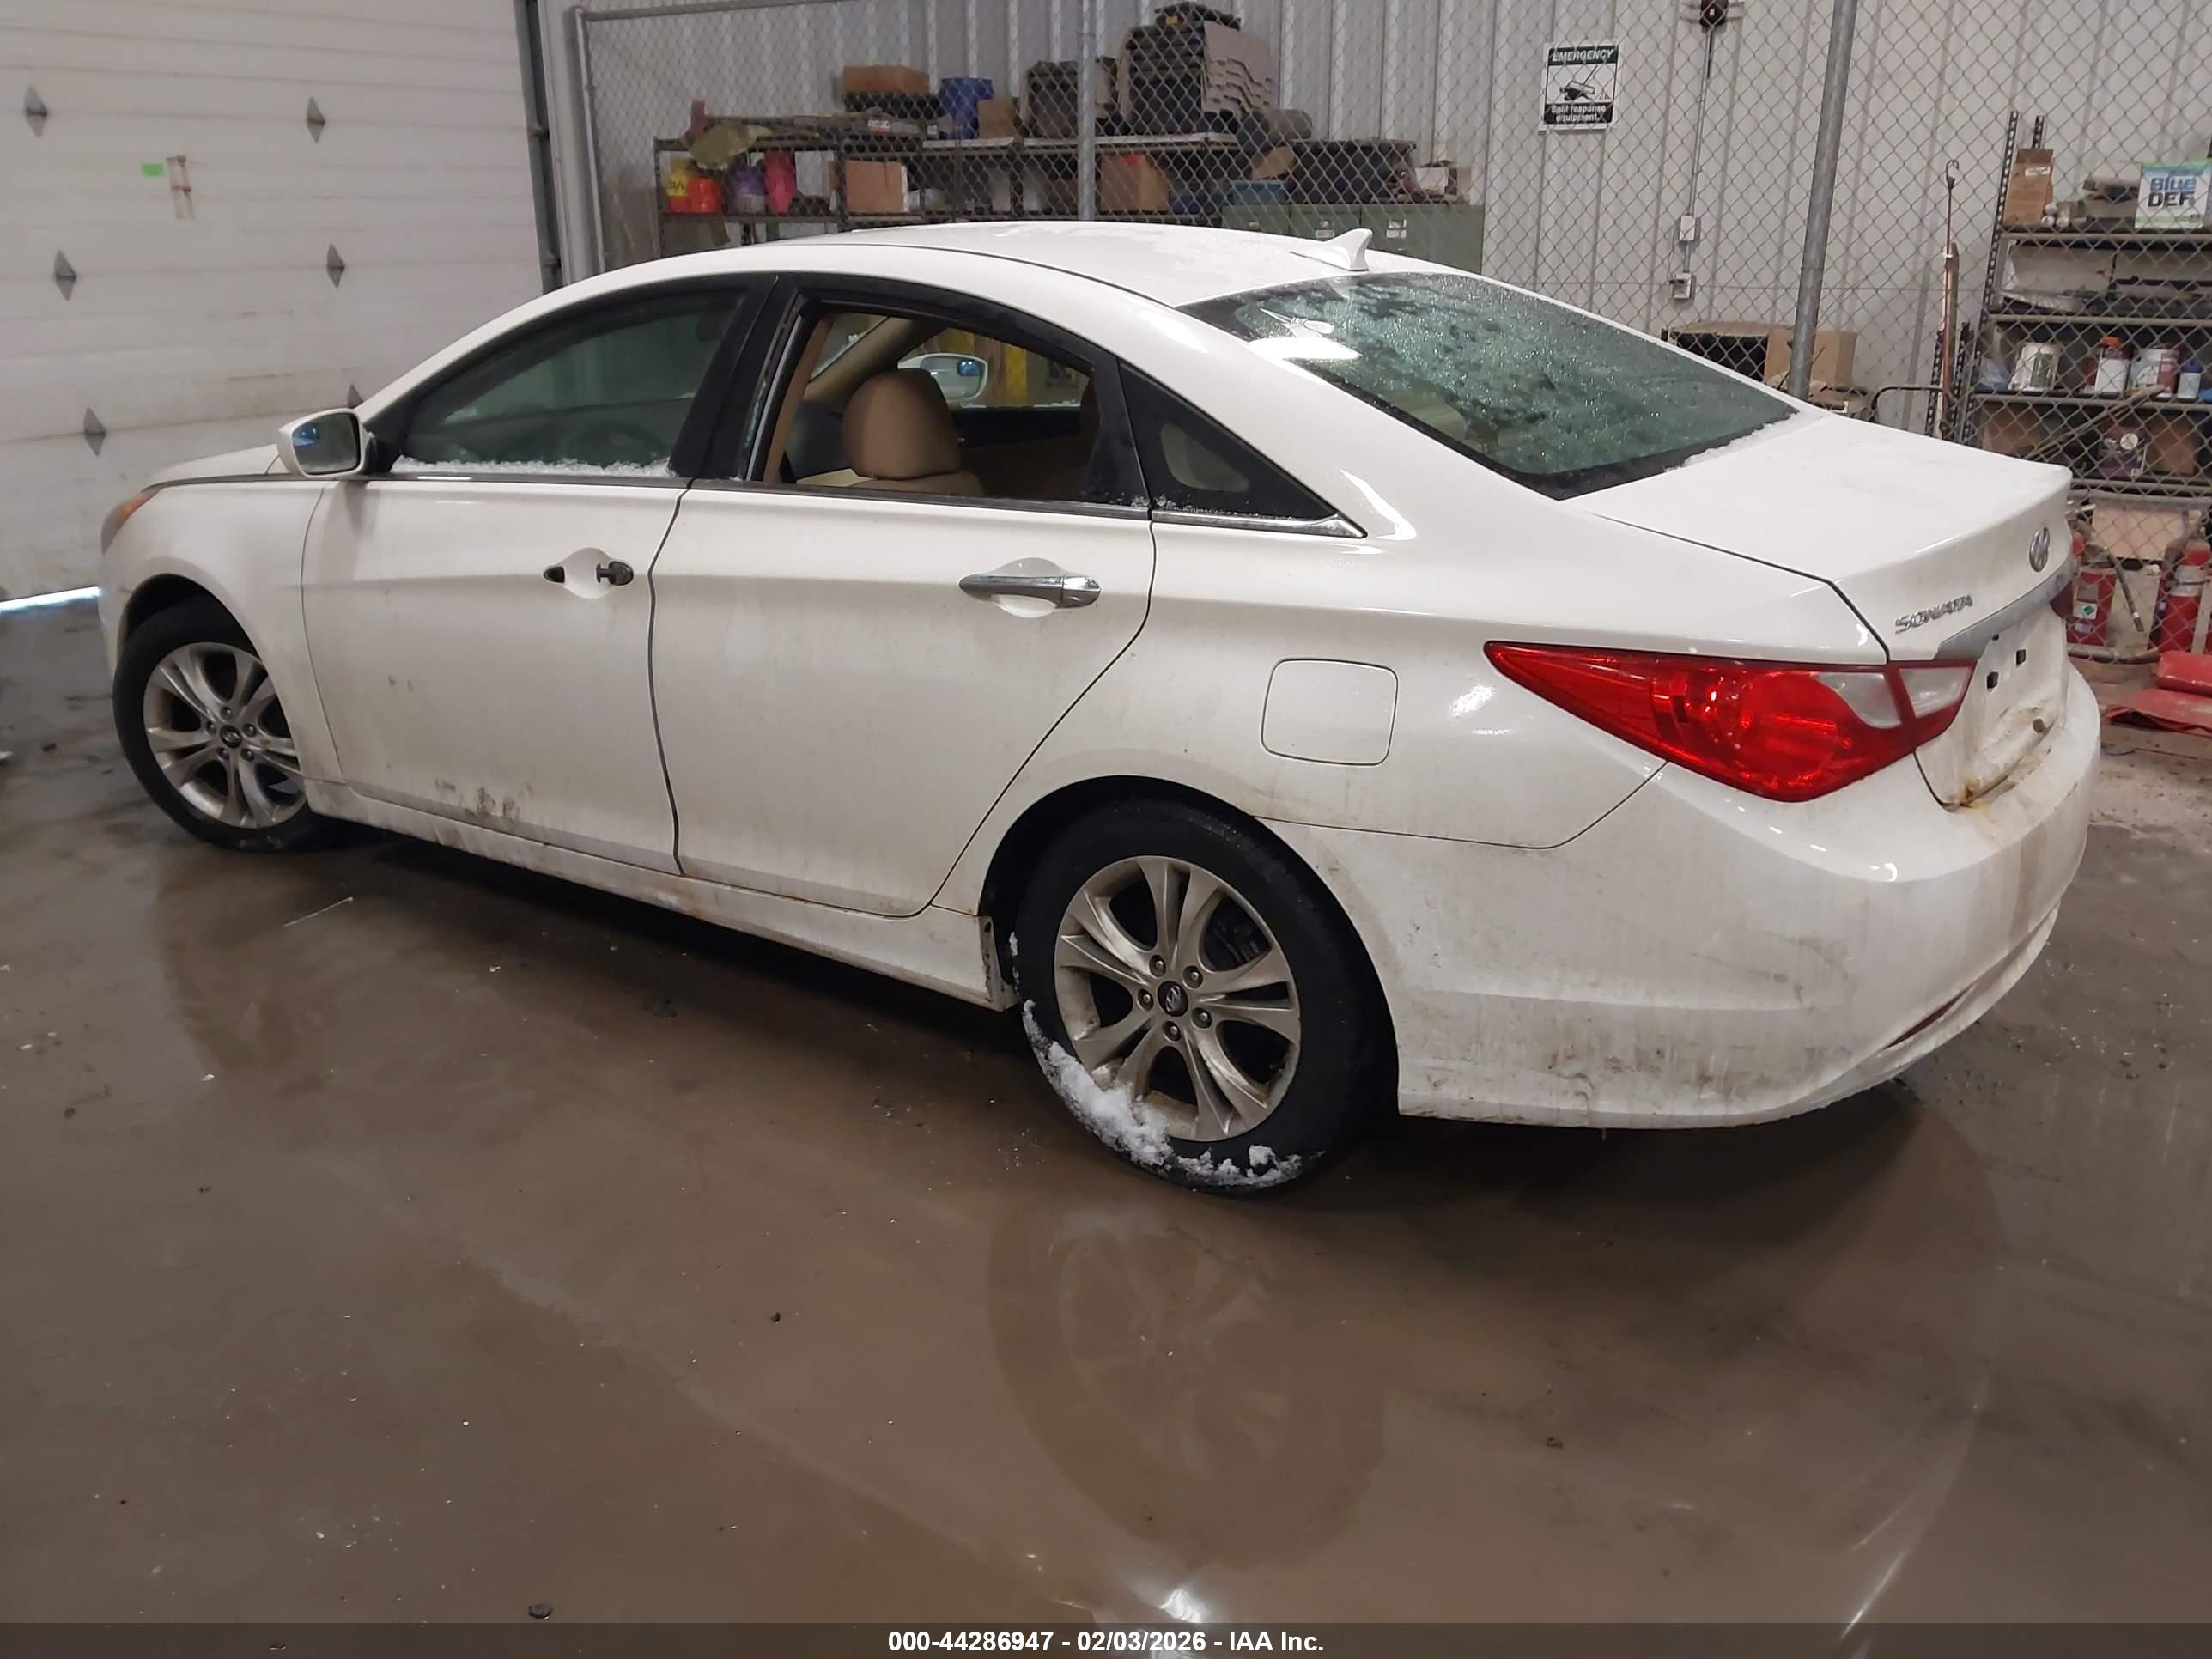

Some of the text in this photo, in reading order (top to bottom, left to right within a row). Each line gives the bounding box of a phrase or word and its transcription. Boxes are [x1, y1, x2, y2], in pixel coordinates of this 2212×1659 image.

[1552, 49, 1613, 62] EMERGENCY
[2148, 191, 2195, 206] DEF
[1895, 595, 1973, 634] SONATA
